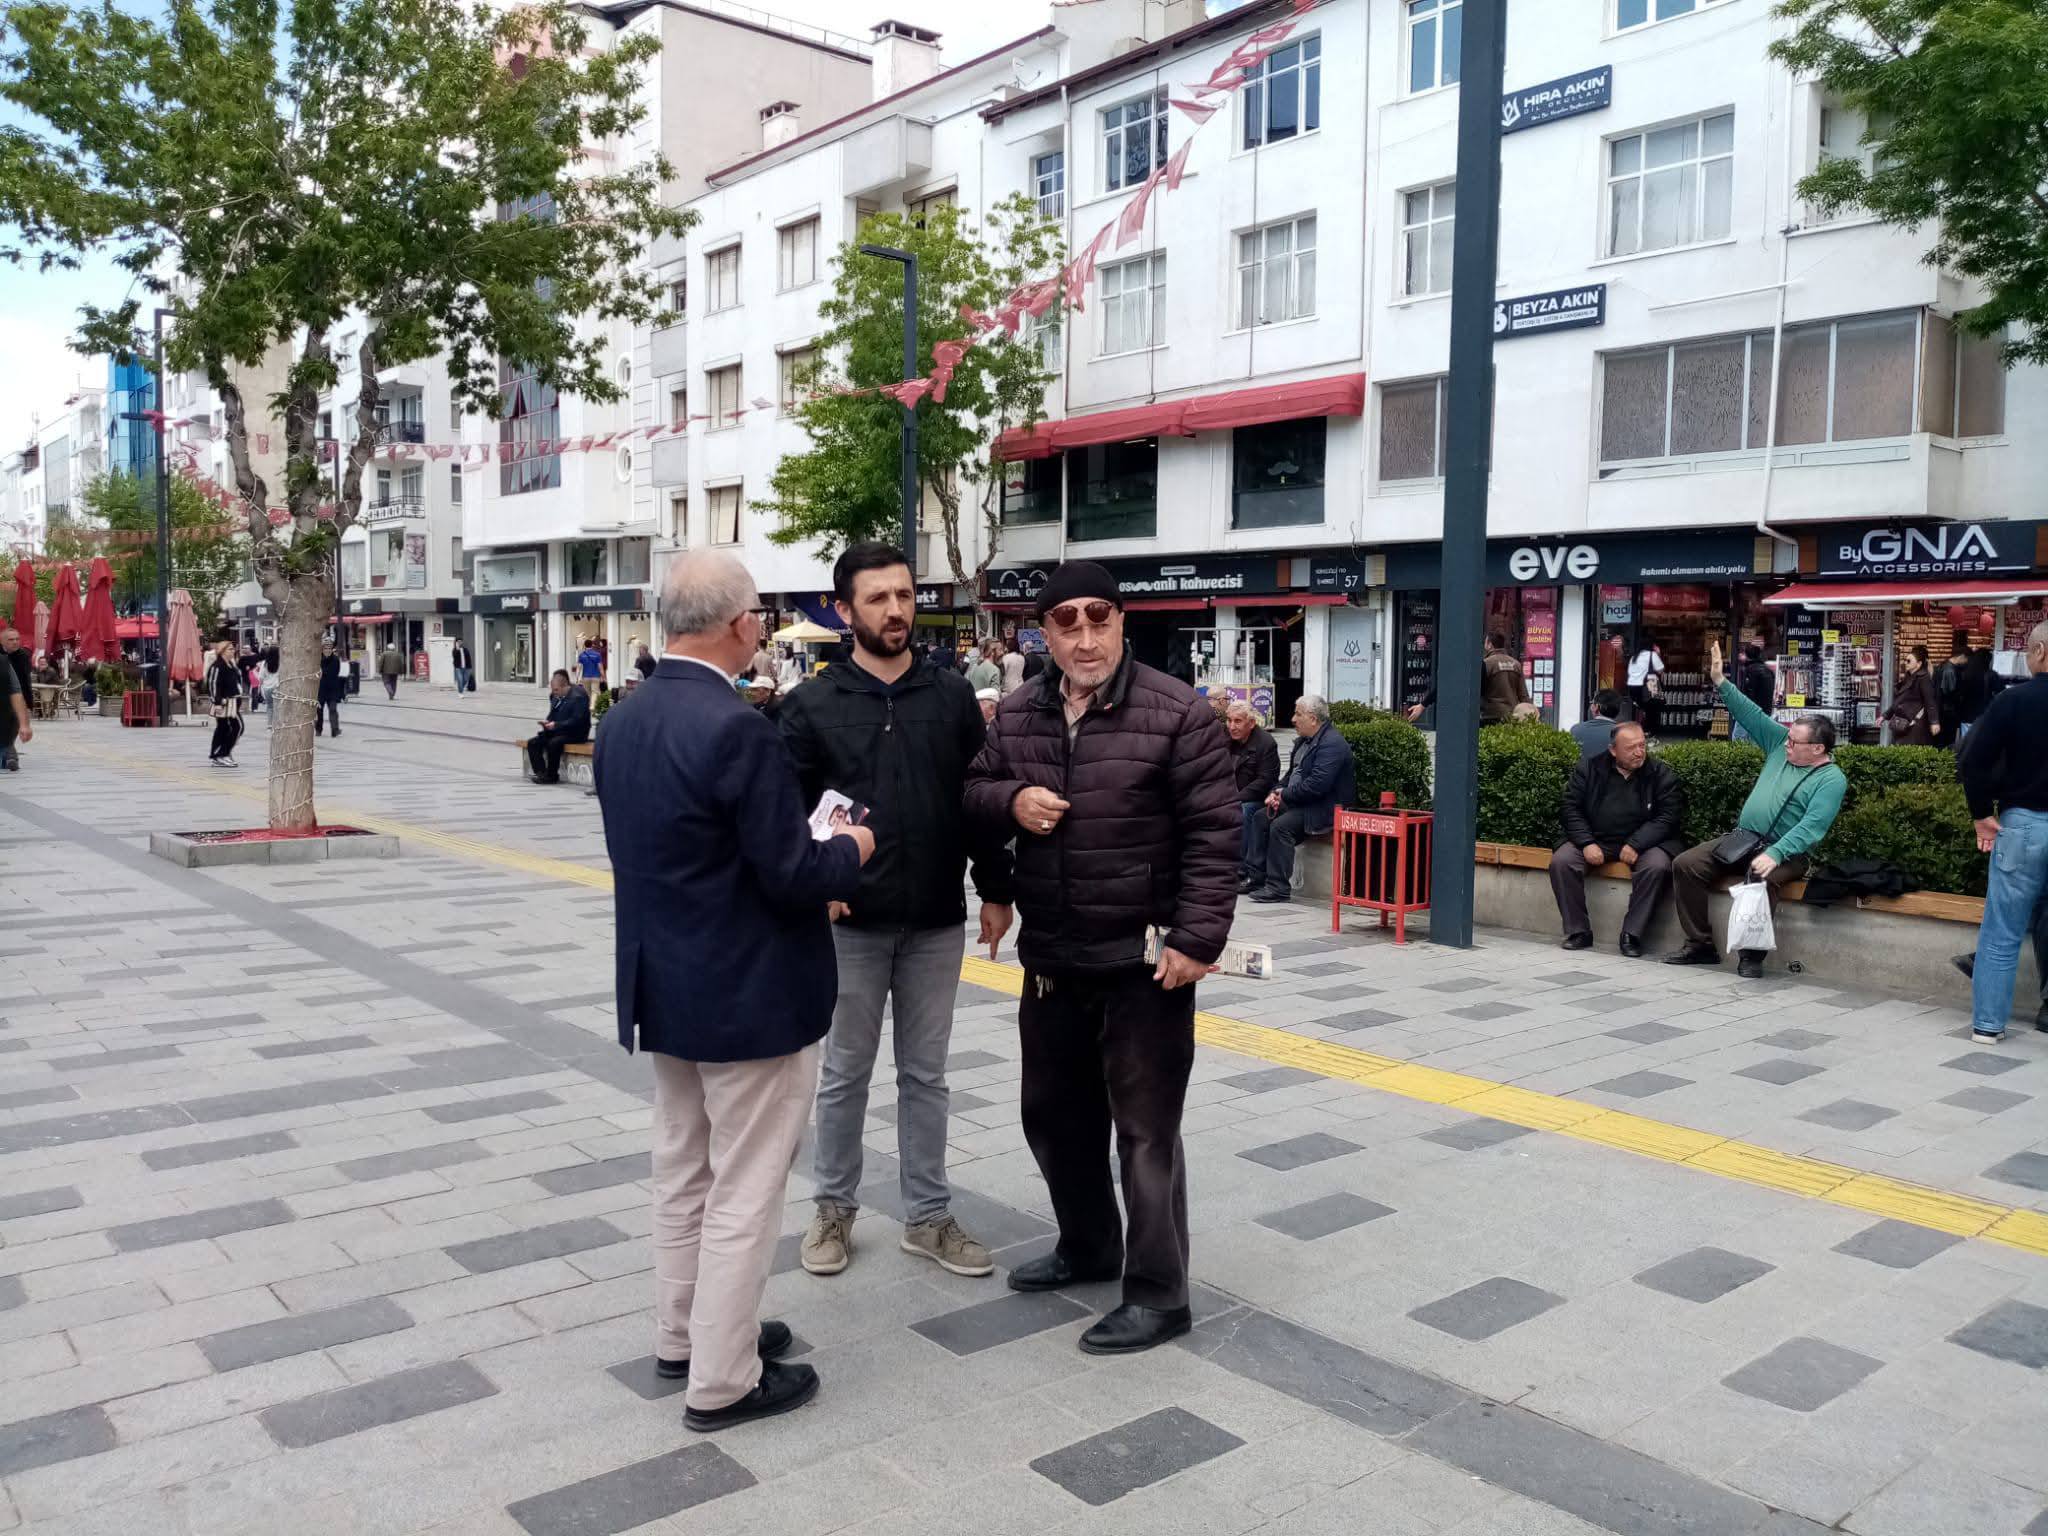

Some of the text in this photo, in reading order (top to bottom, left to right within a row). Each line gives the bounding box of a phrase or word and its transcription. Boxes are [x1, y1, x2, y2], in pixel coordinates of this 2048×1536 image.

[1564, 75, 1605, 97] AKIN
[1512, 290, 1599, 317] BEYZA AKIN
[1509, 545, 1600, 581] eve
[1859, 561, 1986, 574] ACCESSORIES
[1344, 575, 1358, 588] 57
[1606, 603, 1631, 615] hadi
